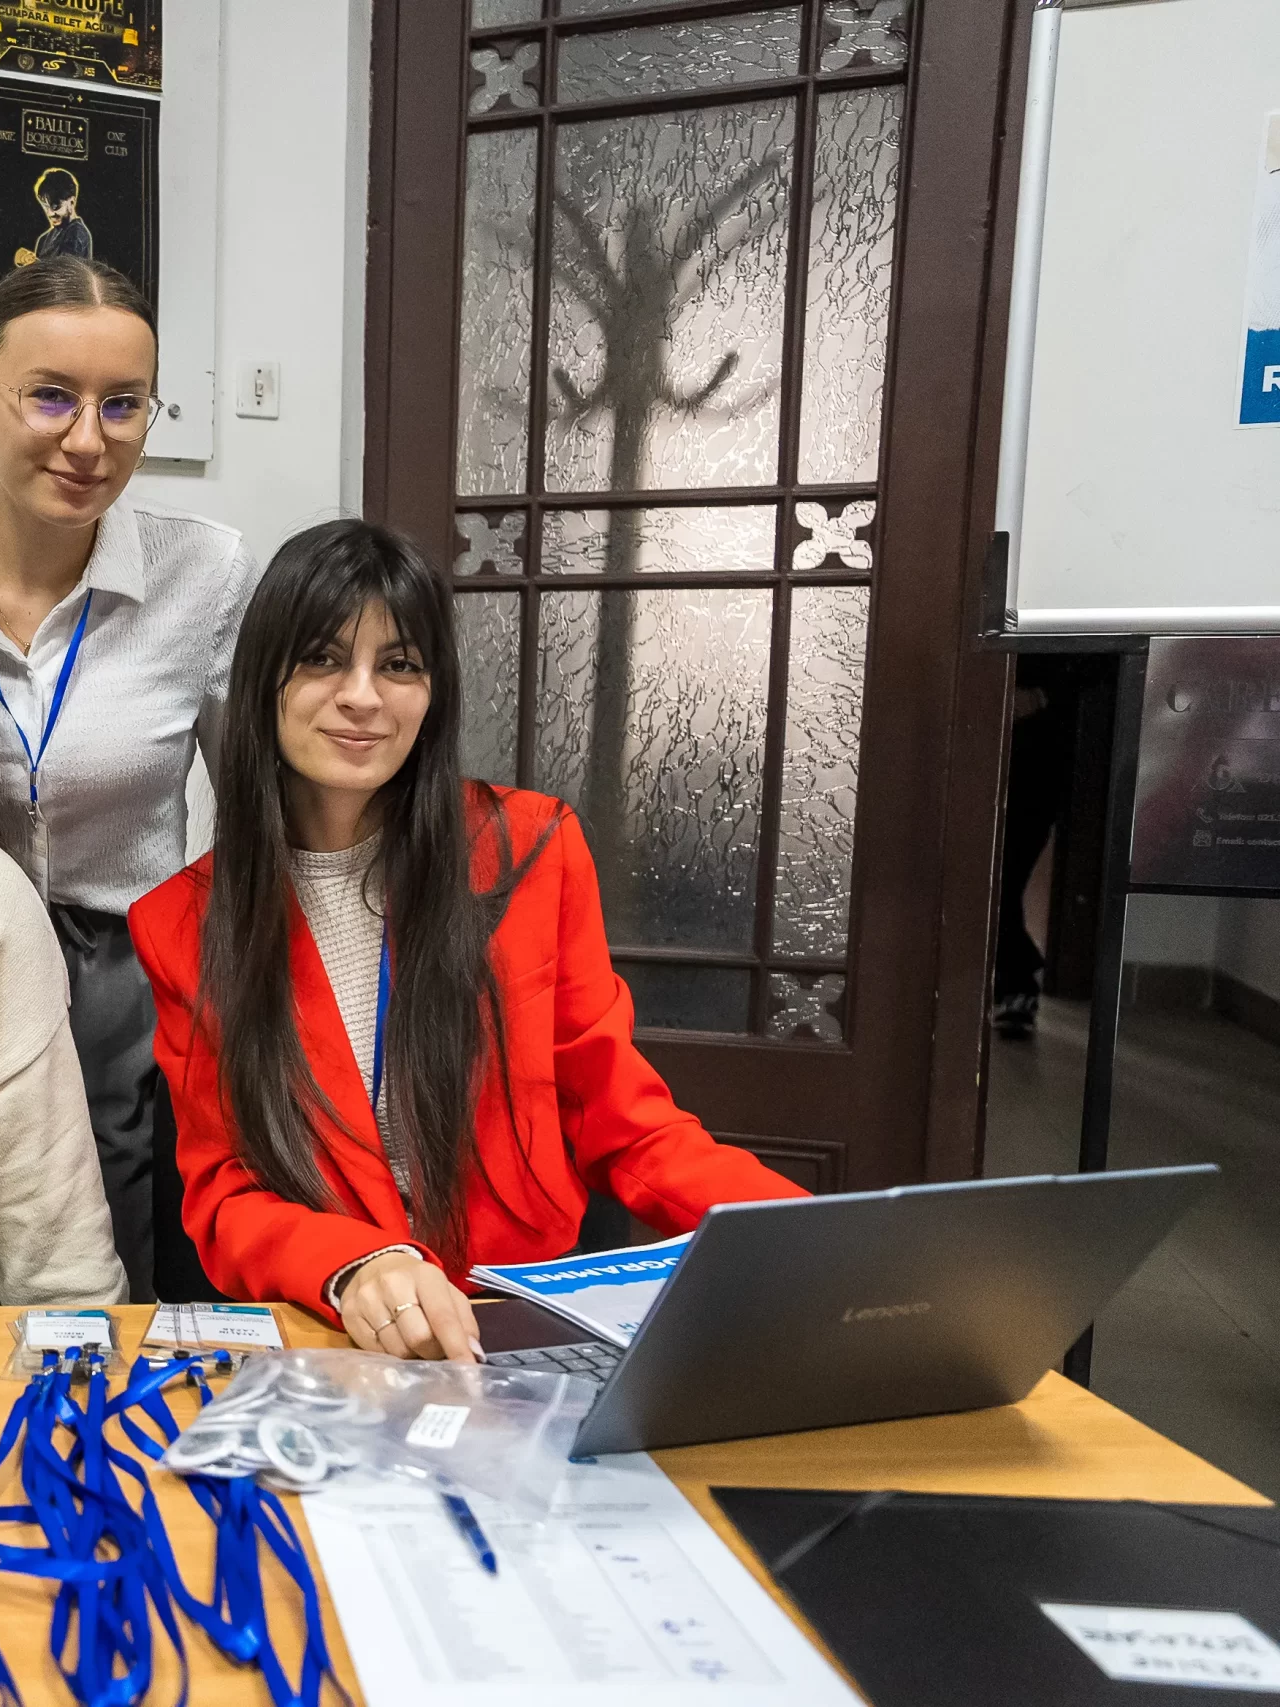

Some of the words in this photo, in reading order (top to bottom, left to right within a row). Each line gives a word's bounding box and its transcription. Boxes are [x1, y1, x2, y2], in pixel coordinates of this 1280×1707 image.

[53, 15, 82, 28] BILET
[84, 20, 116, 33] ACUM
[35, 116, 76, 135] BALUL
[107, 131, 127, 143] ONE
[104, 145, 128, 157] CLUB
